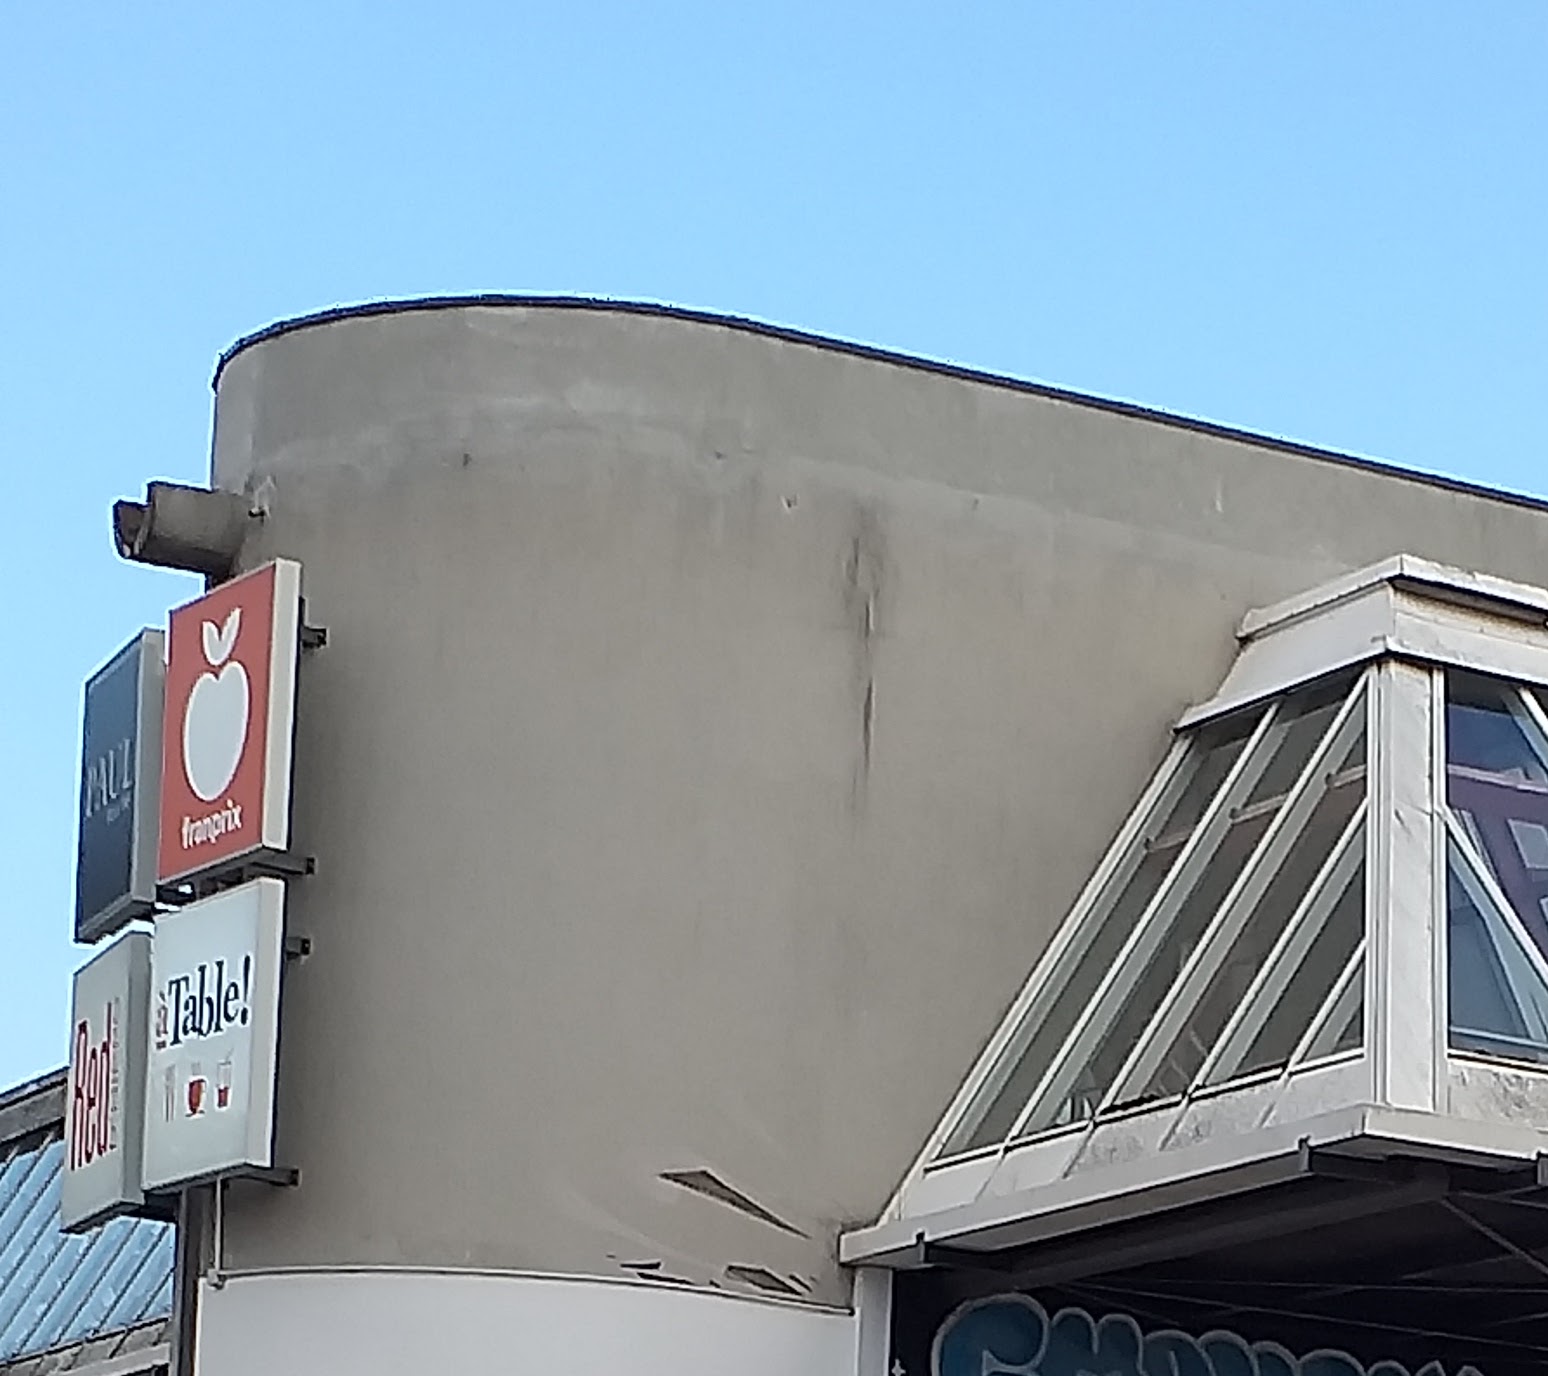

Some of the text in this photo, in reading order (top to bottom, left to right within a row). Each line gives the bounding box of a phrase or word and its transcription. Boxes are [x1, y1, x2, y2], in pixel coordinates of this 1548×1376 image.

[84, 738, 133, 818] PAUL
[181, 798, 242, 850] franprix
[168, 955, 250, 1046] Table!
